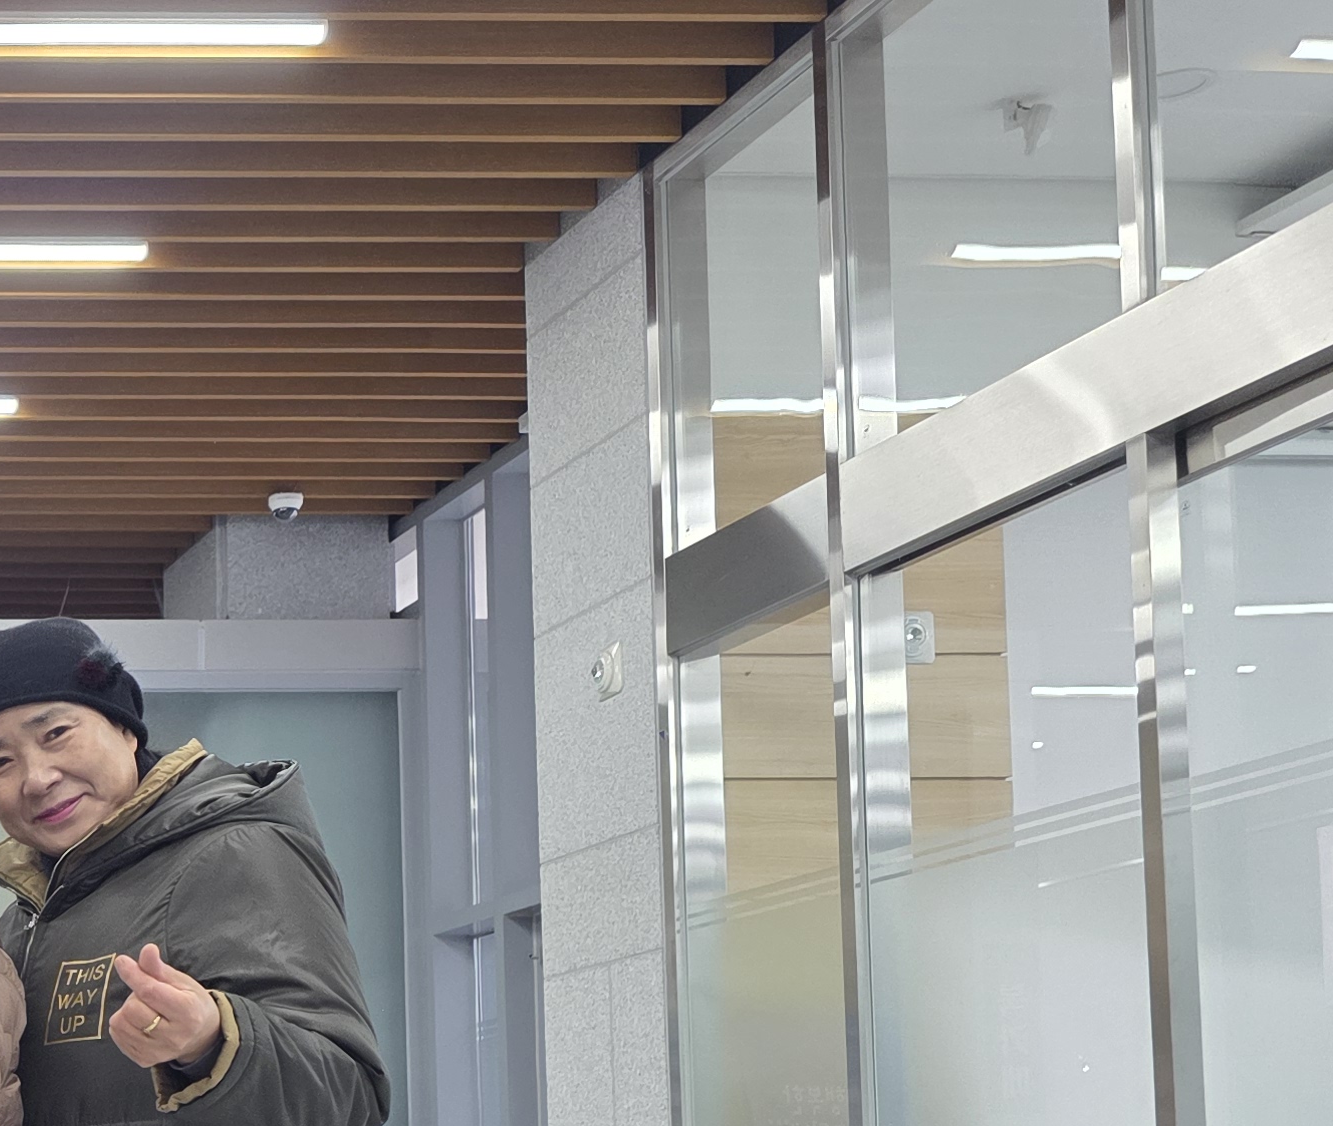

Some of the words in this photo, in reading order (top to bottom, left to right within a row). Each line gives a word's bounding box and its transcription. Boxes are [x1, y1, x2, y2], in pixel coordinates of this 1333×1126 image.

[65, 964, 105, 986] THIS
[58, 988, 97, 1010] WAY
[60, 1015, 85, 1034] UP
